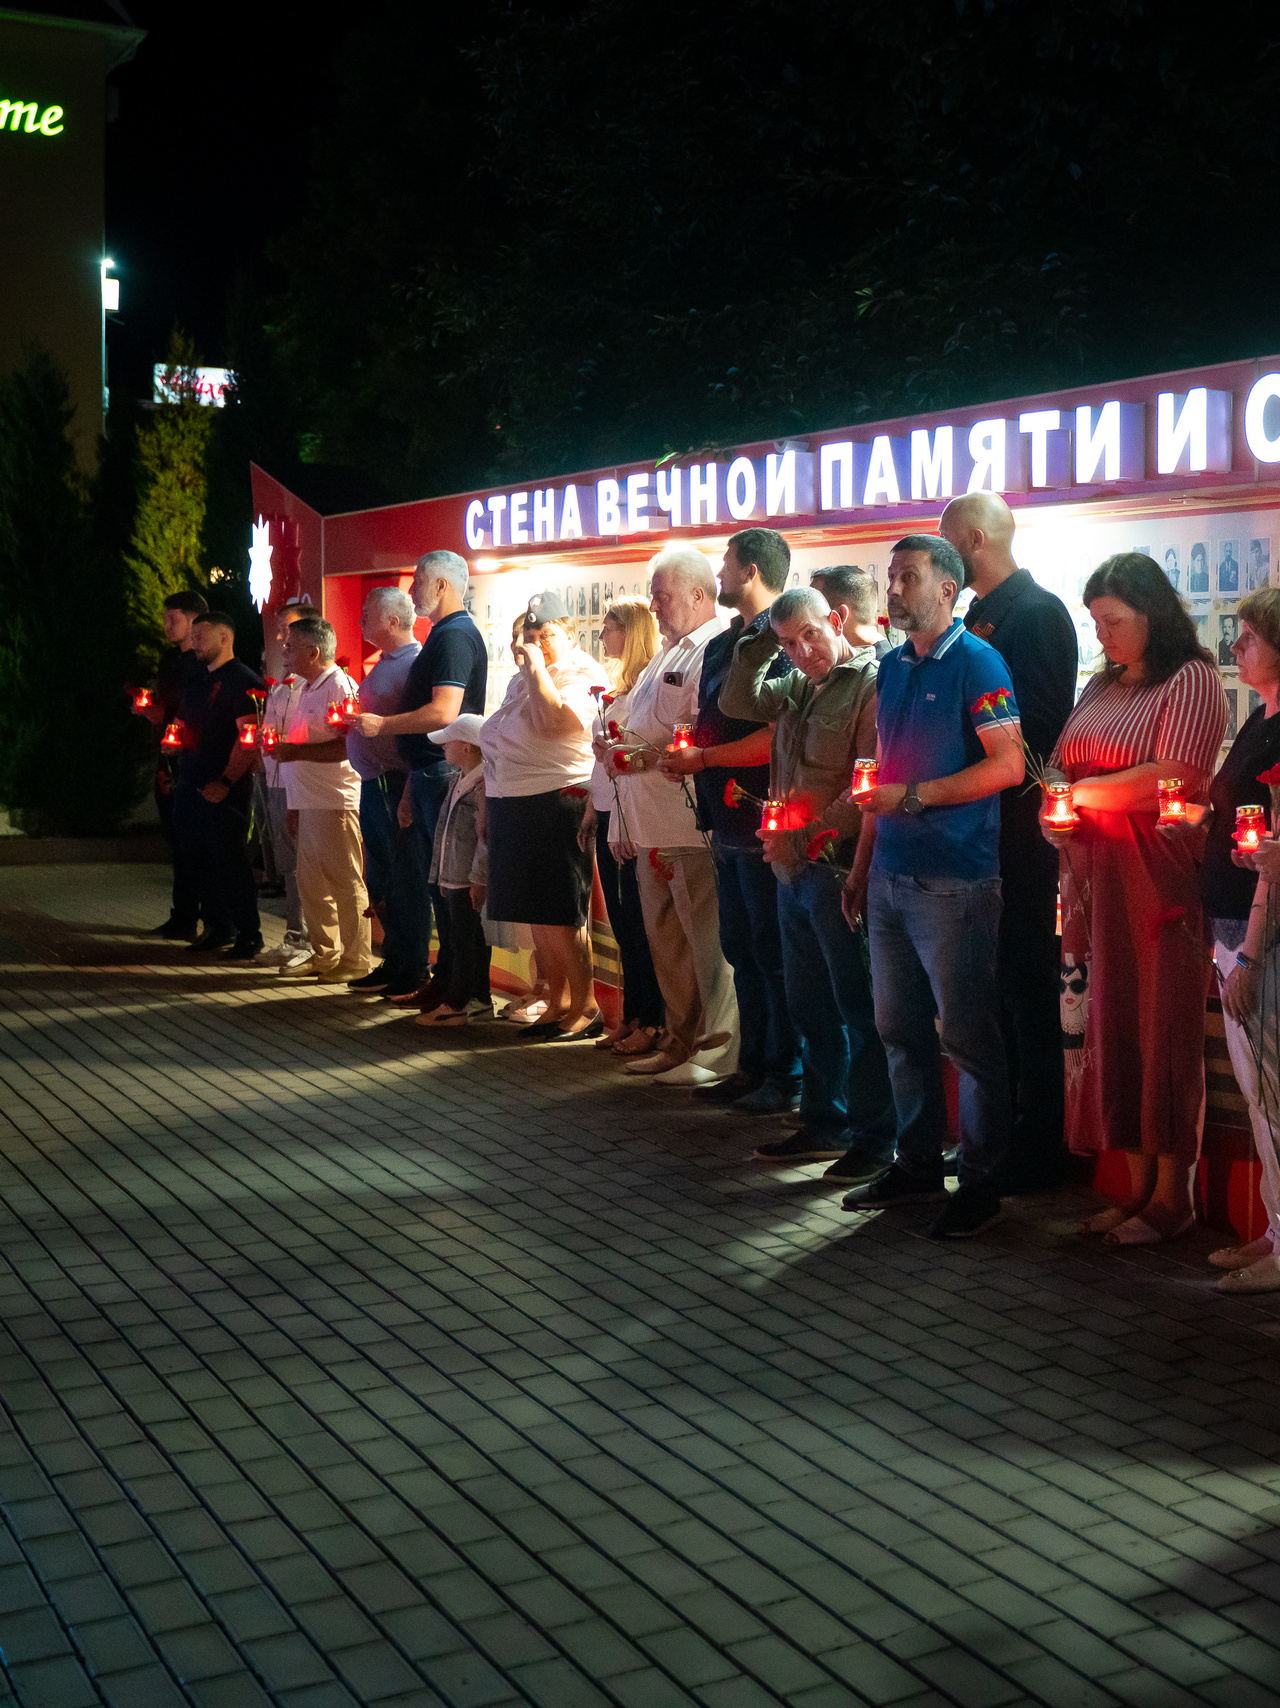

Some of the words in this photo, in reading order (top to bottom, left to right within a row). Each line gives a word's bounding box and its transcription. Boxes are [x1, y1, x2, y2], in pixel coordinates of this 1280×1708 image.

[465, 484, 583, 550] СТЕНА
[820, 400, 1121, 511] ПАМЯТИ
[1157, 387, 1208, 475] И
